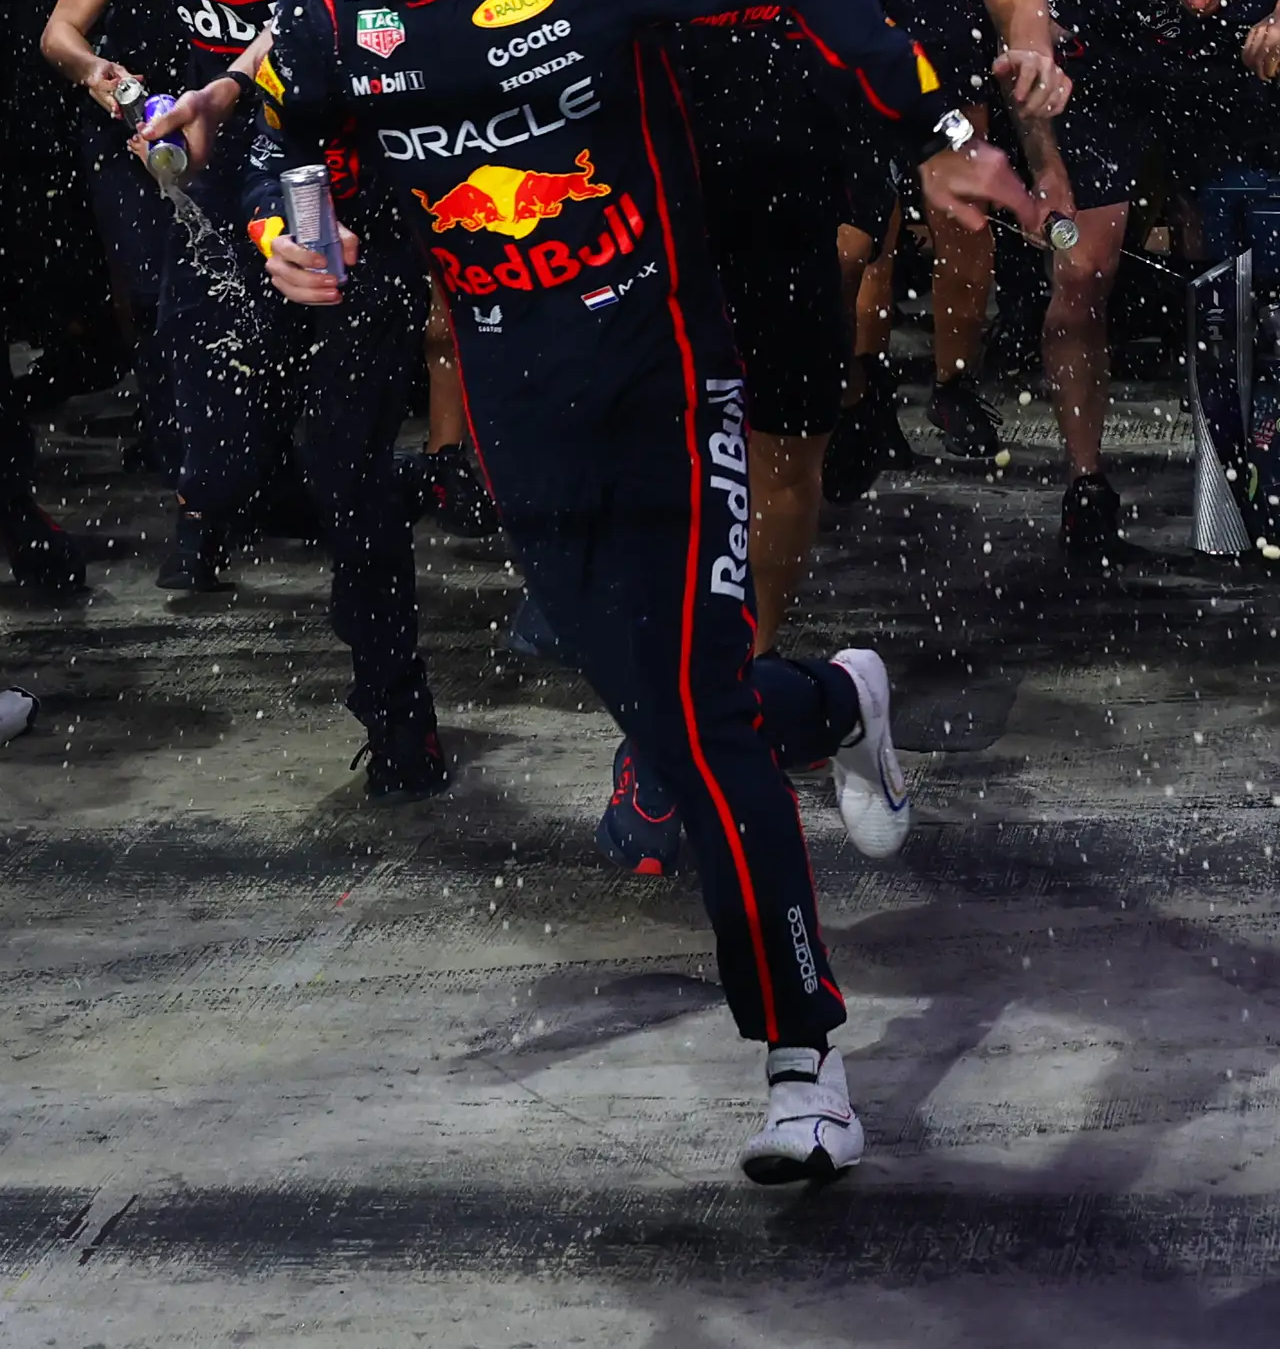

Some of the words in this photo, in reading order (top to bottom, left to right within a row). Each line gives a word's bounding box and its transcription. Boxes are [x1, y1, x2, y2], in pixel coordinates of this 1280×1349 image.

[360, 11, 399, 29] TAG
[508, 19, 571, 58] Gate
[360, 29, 401, 54] HEUER
[351, 71, 407, 97] Mobil
[499, 51, 585, 92] HONDA
[378, 76, 601, 160] ORACLE
[787, 904, 818, 994] sparco
